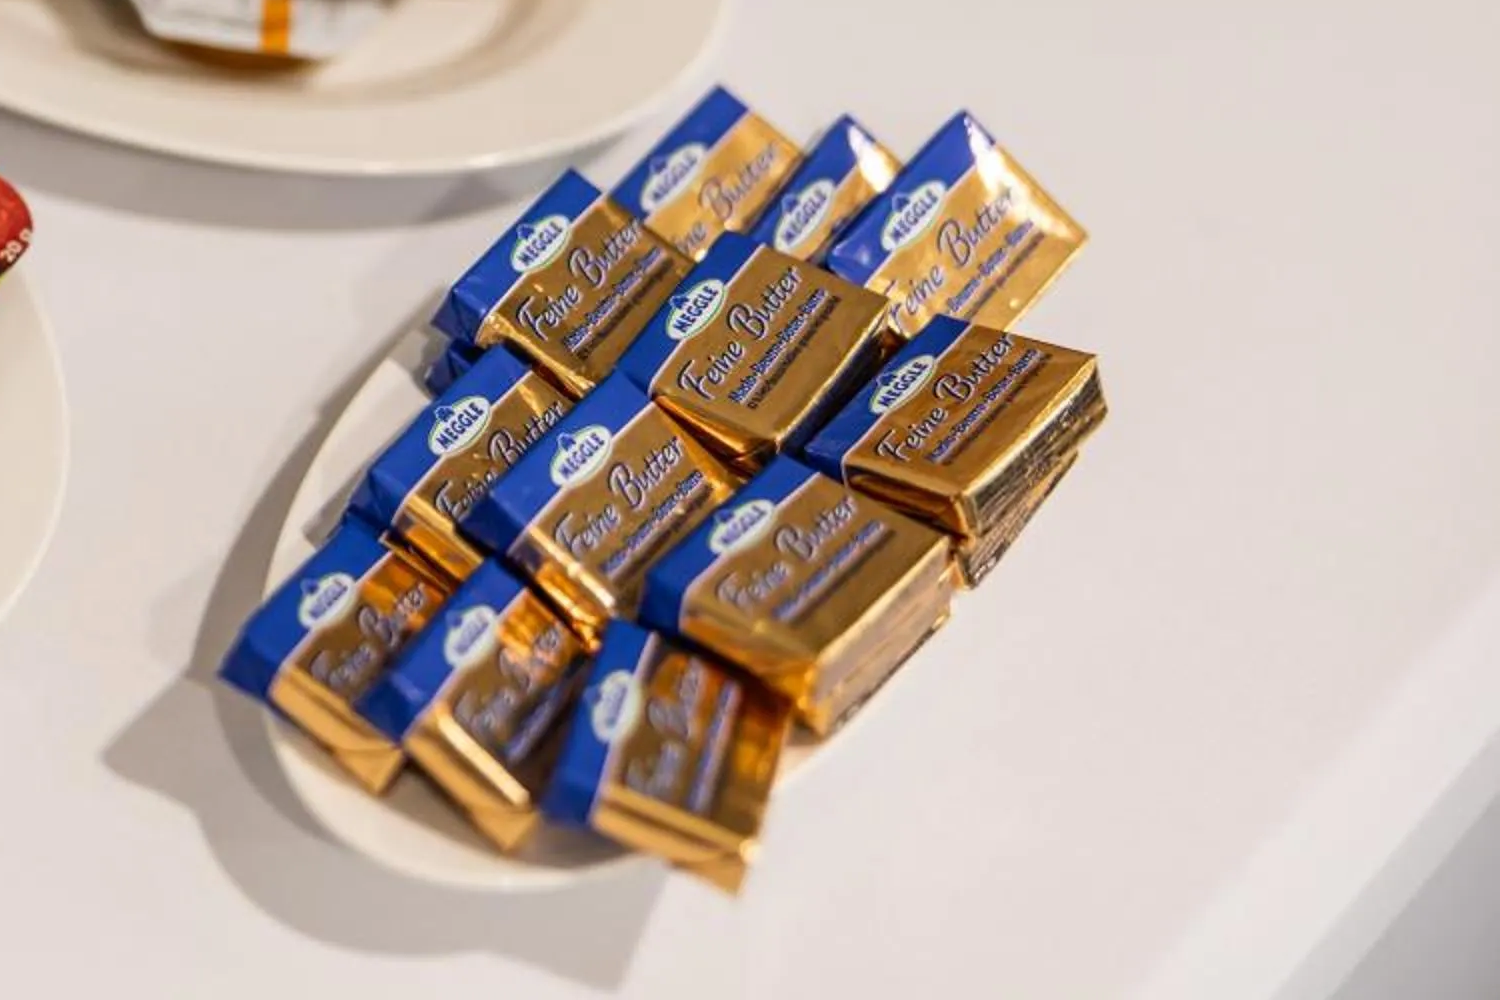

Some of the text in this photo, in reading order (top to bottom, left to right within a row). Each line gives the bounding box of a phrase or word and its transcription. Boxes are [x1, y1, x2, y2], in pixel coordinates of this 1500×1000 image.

[699, 142, 779, 222] Butter
[515, 221, 564, 266] MEGGLE
[890, 188, 940, 245] MEGGLE
[937, 185, 1013, 267] Butter
[0, 240, 21, 262] 20
[515, 284, 584, 341] Feine
[568, 218, 647, 288] Butter
[673, 285, 719, 333] MEGGLE
[676, 339, 746, 400] Feine
[726, 265, 802, 341] Butter
[875, 406, 948, 462] Feine
[932, 332, 1016, 405] Butter
[878, 361, 928, 408] MEGGLE
[435, 402, 484, 450] MEGGLE
[557, 431, 606, 480] MEGGLE
[554, 502, 621, 558] Feine
[607, 434, 685, 511] Butter
[715, 559, 792, 613] Feine
[773, 496, 858, 564] Butter
